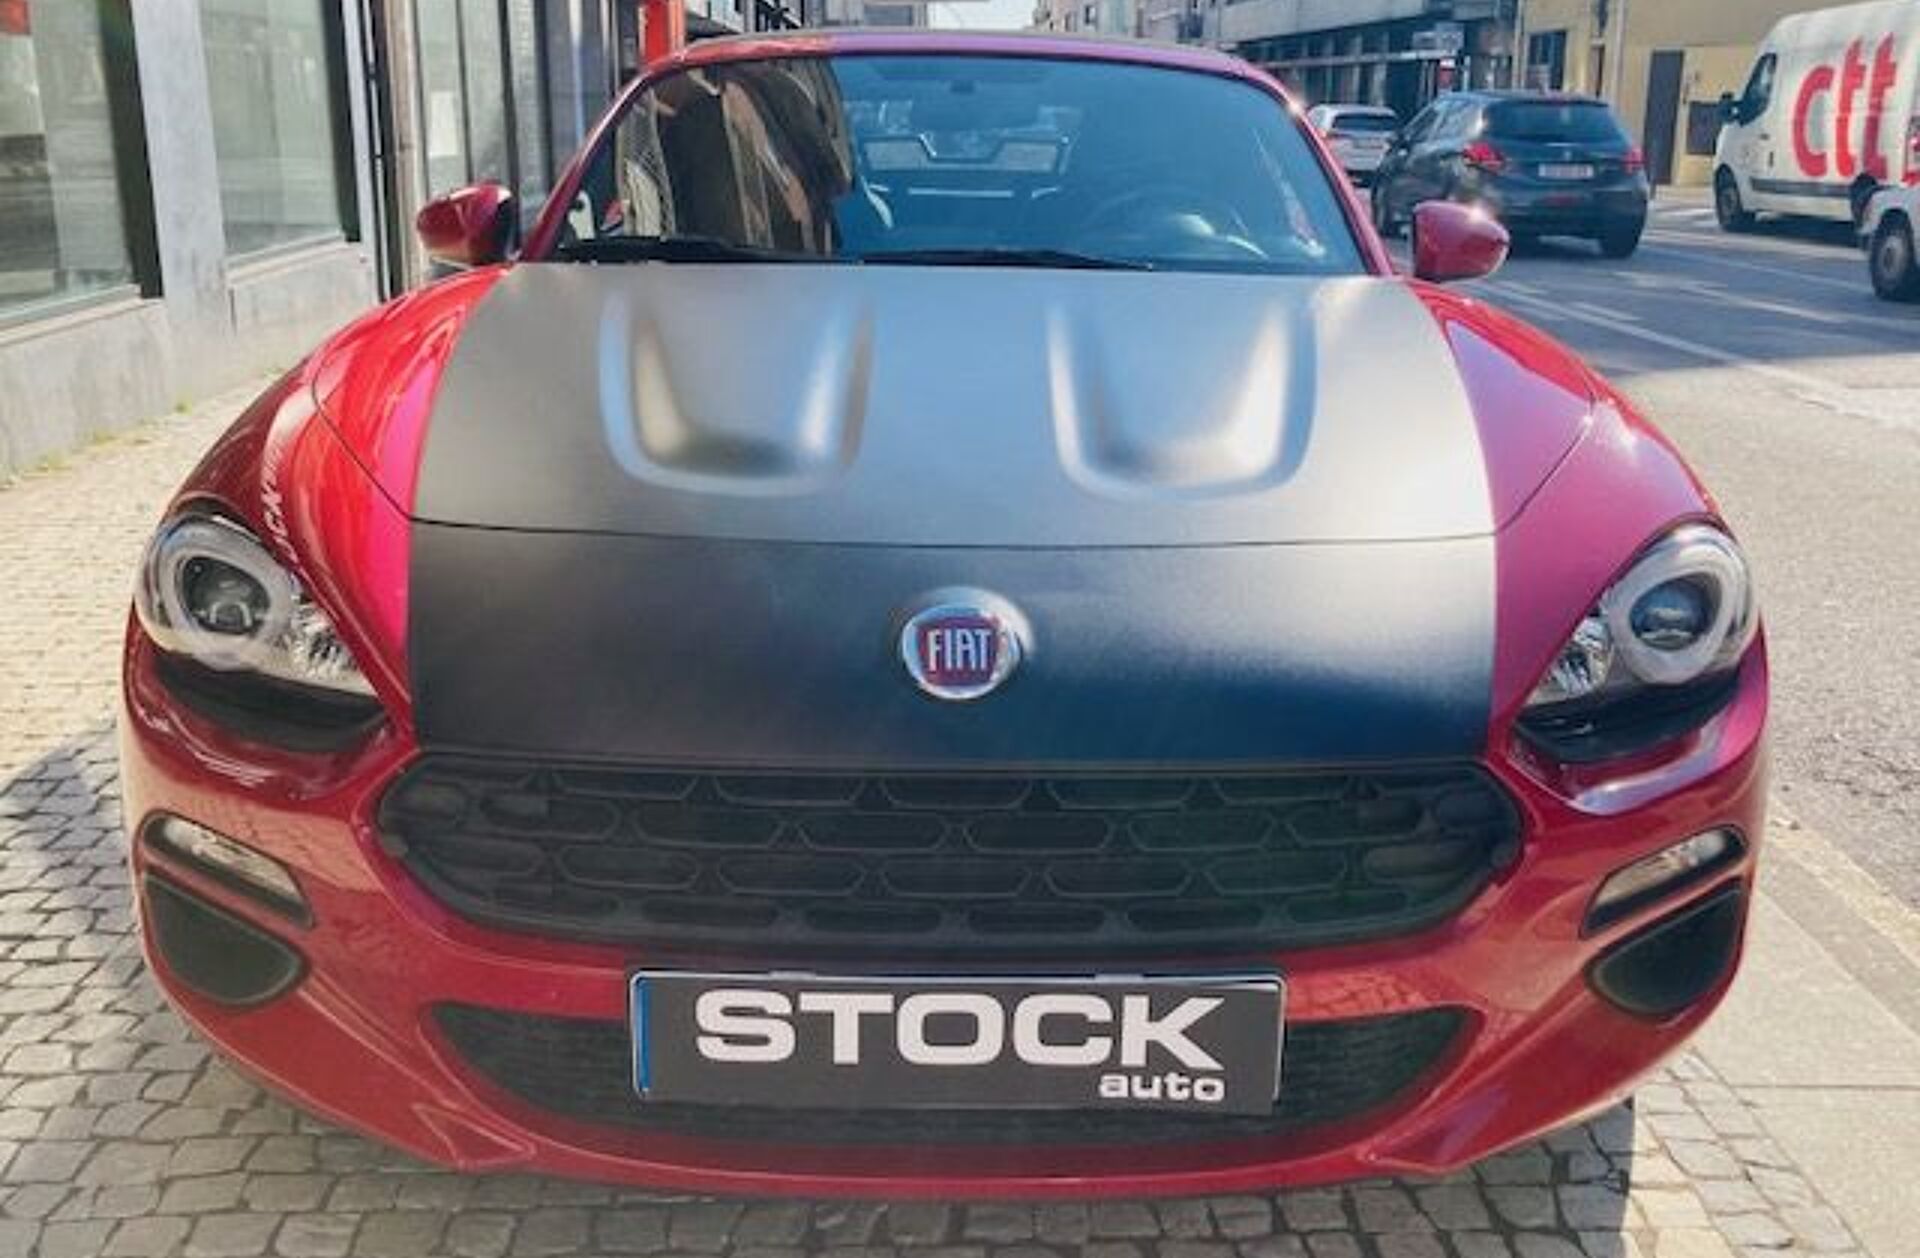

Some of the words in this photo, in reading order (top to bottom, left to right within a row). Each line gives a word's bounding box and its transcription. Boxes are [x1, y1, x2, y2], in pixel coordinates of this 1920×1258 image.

[1793, 32, 1898, 179] ctt
[927, 627, 992, 672] FIAT
[695, 989, 1225, 1070] STOCK
[1099, 1072, 1225, 1102] auto
